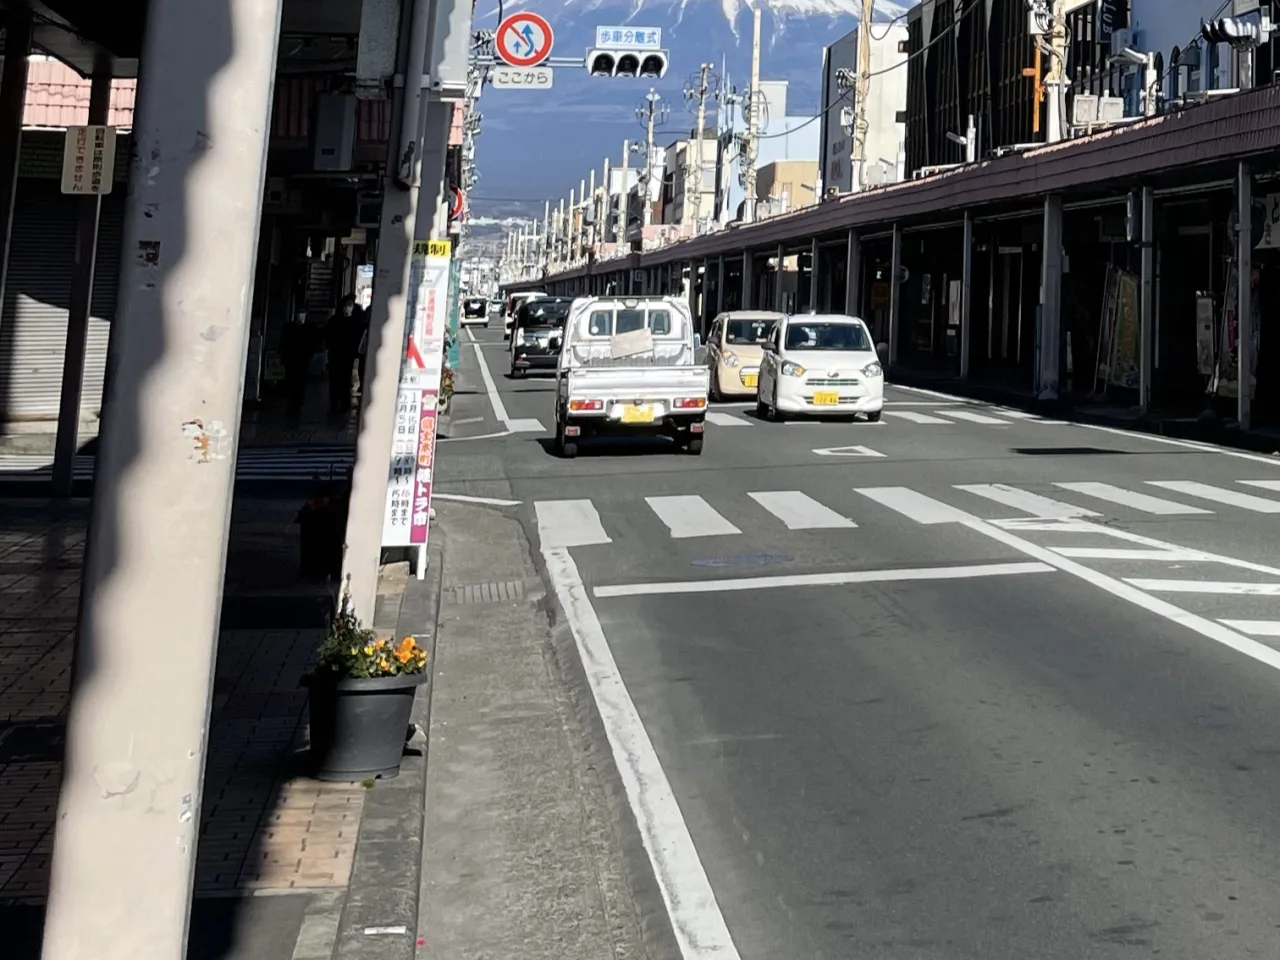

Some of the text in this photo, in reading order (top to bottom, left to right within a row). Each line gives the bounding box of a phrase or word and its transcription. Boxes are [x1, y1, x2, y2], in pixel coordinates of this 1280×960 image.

[601, 30, 657, 44] 歩車分離式
[498, 72, 548, 84] ここから
